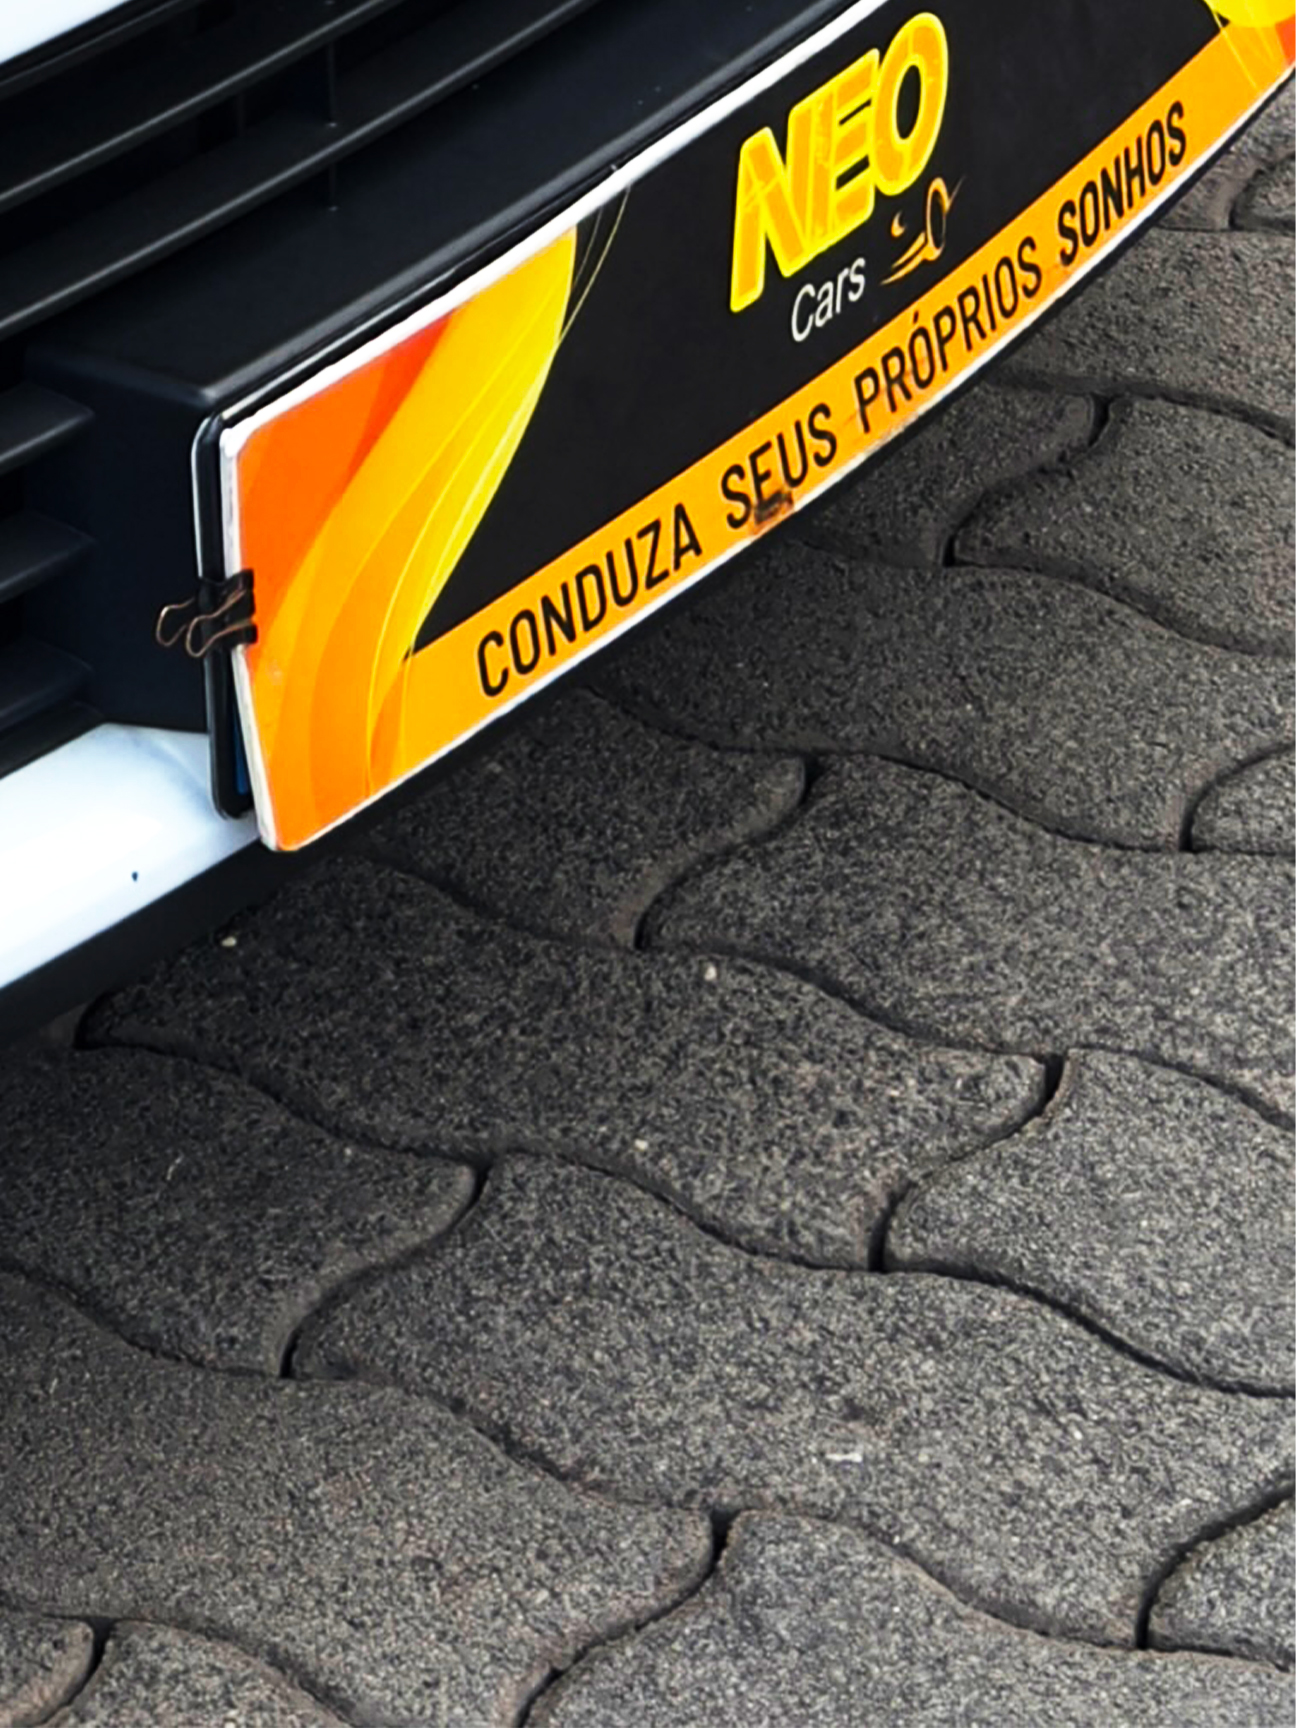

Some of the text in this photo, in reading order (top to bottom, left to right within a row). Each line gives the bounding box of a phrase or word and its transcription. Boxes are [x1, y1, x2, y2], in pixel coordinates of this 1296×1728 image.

[730, 12, 949, 313] NEO
[791, 257, 866, 342] Cars
[477, 100, 1187, 698] CONDUZA SEUS PRÓPRIOS SONHOS
